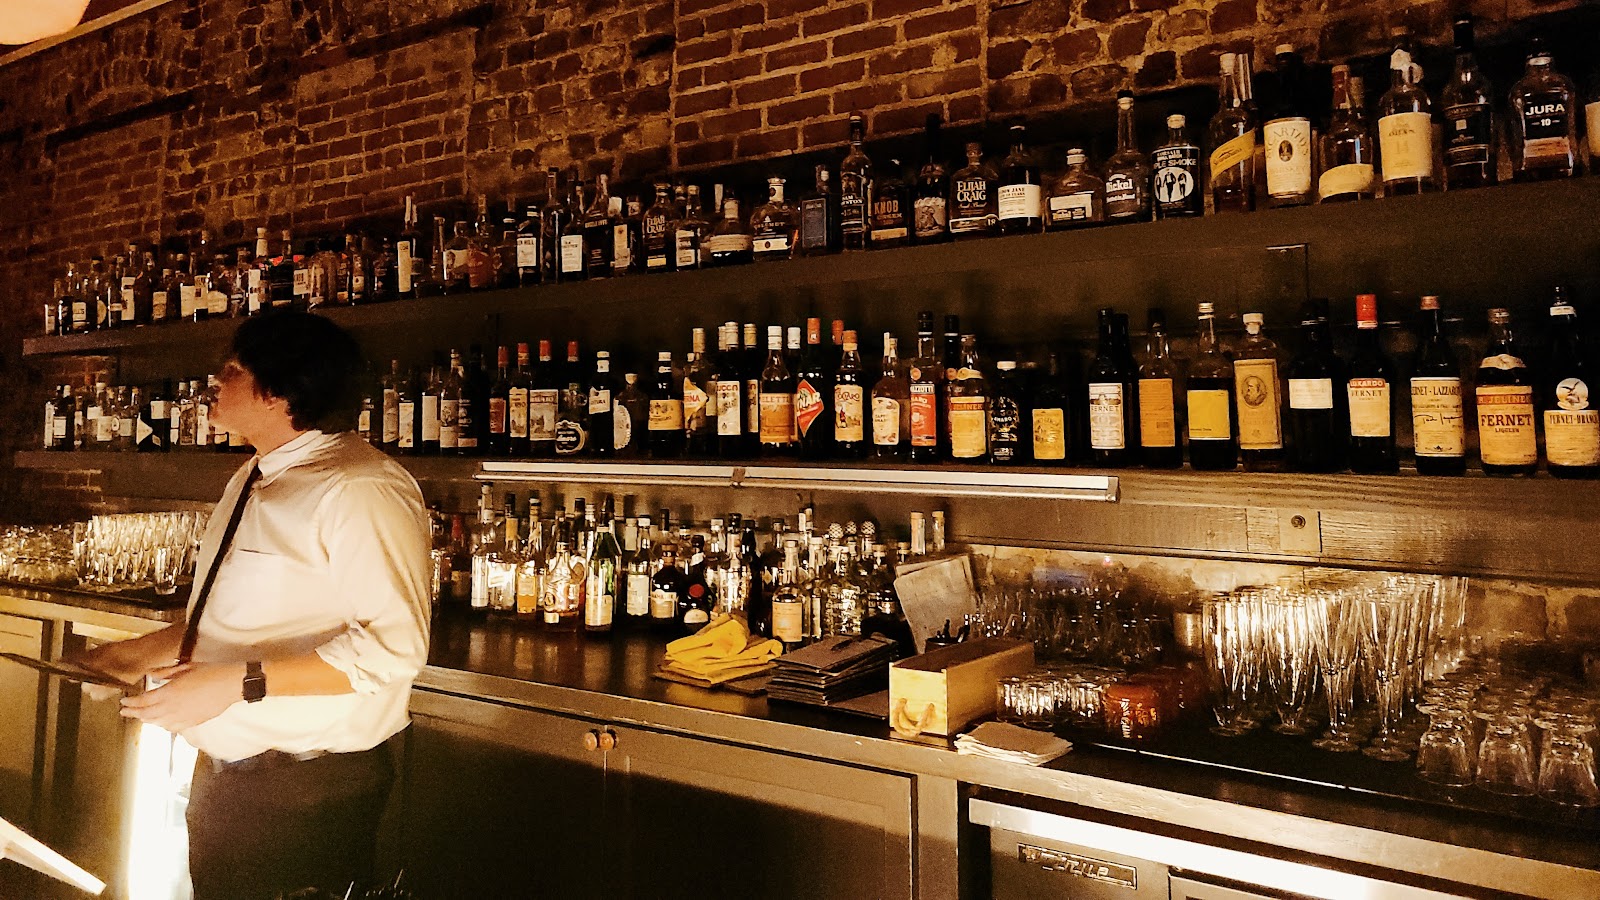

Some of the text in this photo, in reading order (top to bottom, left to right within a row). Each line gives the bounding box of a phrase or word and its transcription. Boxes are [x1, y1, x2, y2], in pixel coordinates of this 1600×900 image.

[1525, 103, 1565, 116] JURA
[1540, 118, 1551, 127] 10
[1154, 158, 1197, 170] PLE SMOKE
[956, 181, 986, 192] ELIJAH
[957, 191, 987, 203] CRAIG
[874, 200, 899, 215] KNOB
[1351, 389, 1383, 397] FERNET
[761, 395, 791, 403] ELETTI
[1091, 404, 1120, 412] FERNET
[1481, 413, 1532, 427] FERNET
